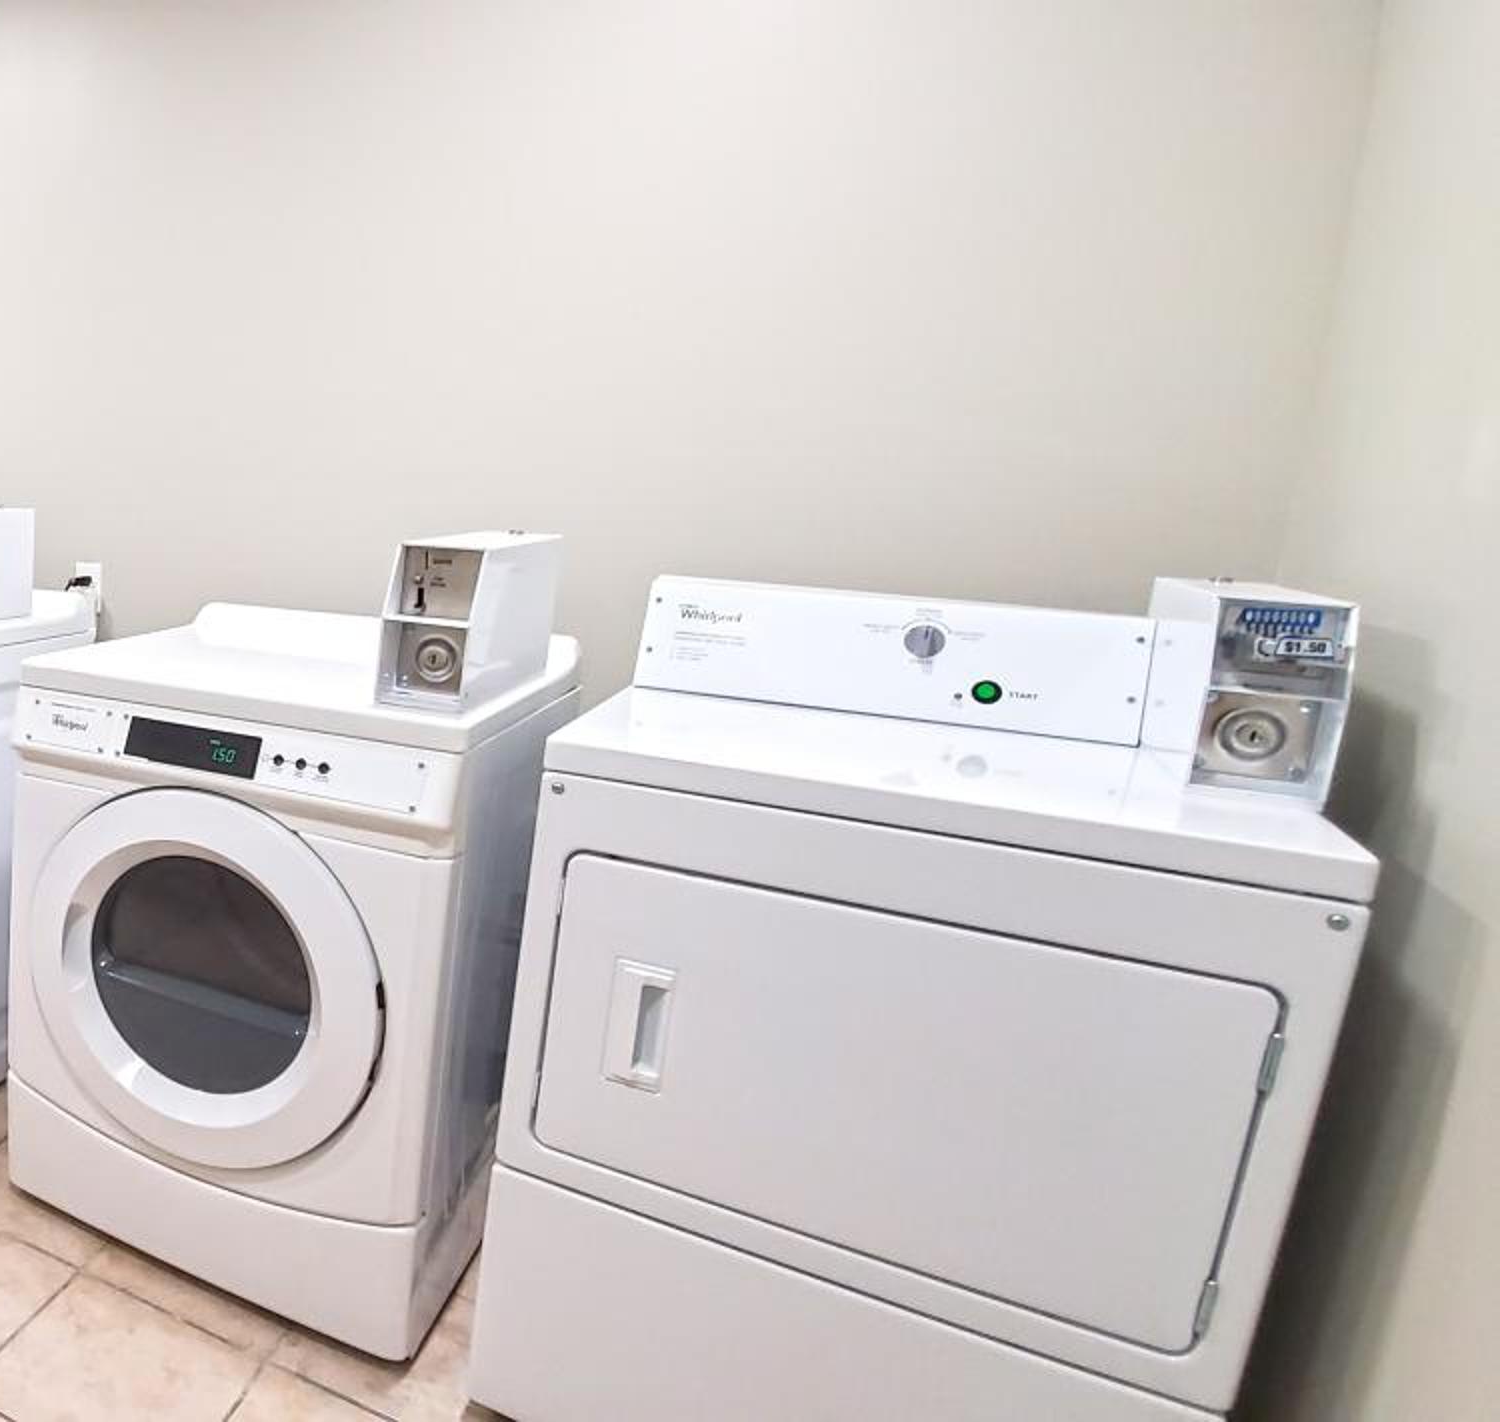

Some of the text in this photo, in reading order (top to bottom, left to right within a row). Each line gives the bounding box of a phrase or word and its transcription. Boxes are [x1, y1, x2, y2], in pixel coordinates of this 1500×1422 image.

[680, 608, 742, 625] Whirlpool
[1284, 640, 1328, 655] $1.50
[1009, 691, 1039, 701] START
